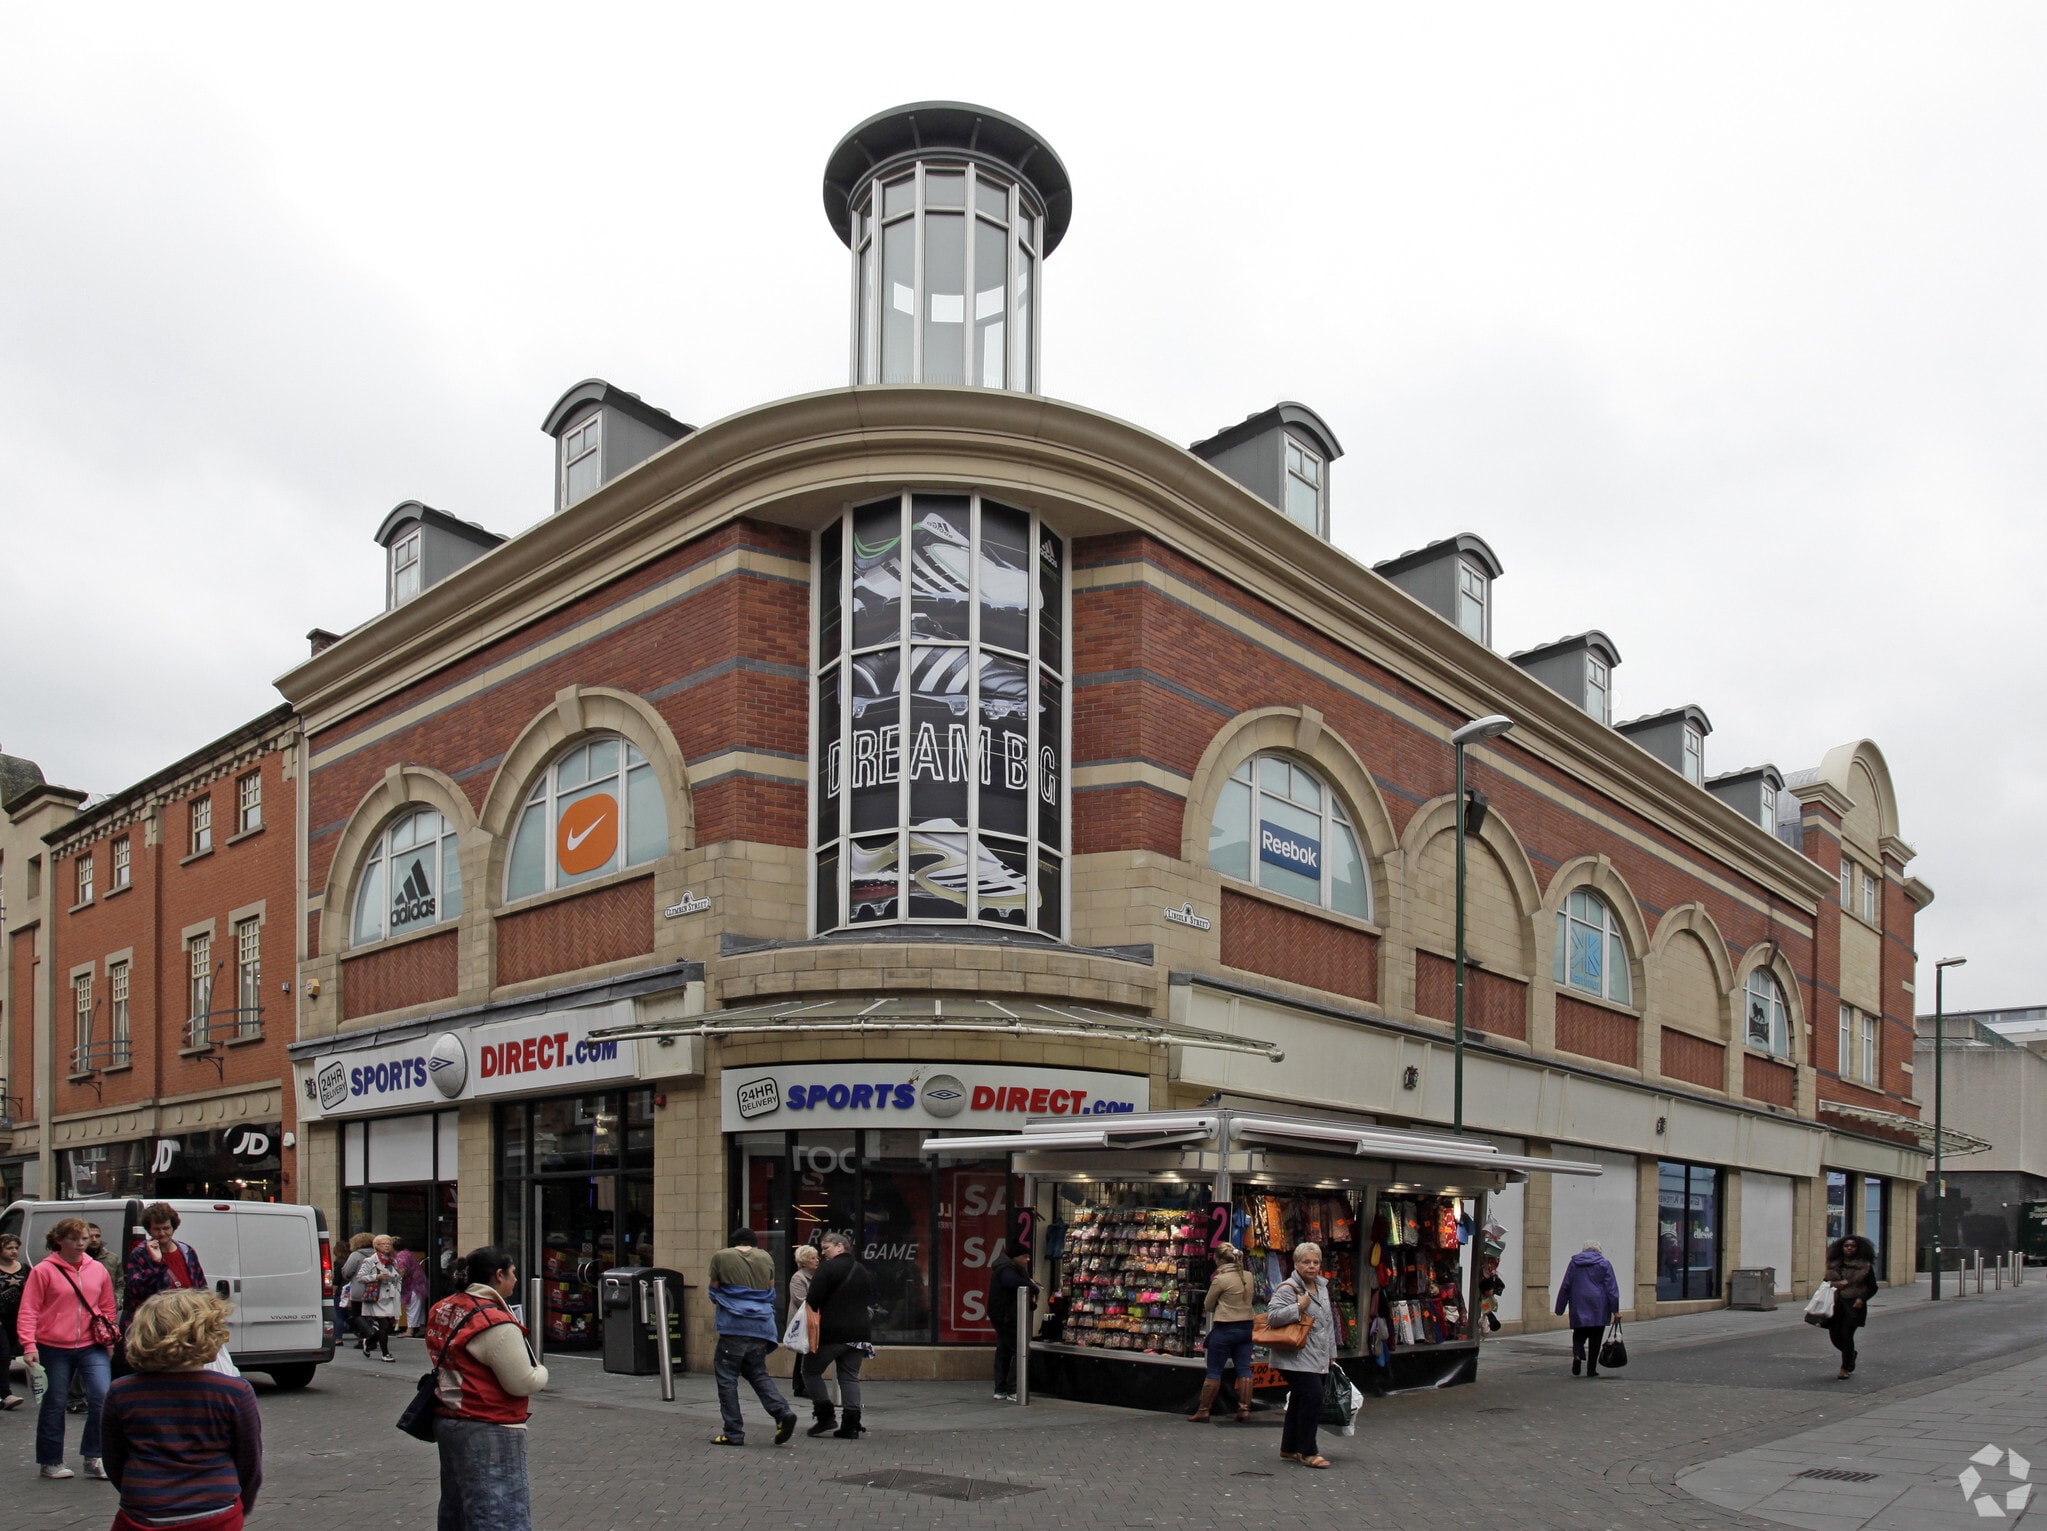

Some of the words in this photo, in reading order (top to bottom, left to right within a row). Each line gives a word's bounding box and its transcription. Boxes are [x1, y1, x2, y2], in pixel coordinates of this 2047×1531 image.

[828, 722, 991, 799] DREAM
[1003, 730, 1056, 806] BG
[1262, 829, 1318, 868] Reebok
[391, 897, 435, 927] adidas
[1190, 915, 1209, 929] STREET
[321, 1068, 343, 1092] 24HR
[350, 1056, 427, 1097] SPORTS
[322, 1081, 347, 1102] DELIVERY
[741, 1083, 774, 1103] 24HR
[742, 1095, 777, 1112] DELIVERY
[785, 1083, 916, 1110] SPORTS
[233, 1131, 270, 1155] JD
[151, 1139, 173, 1174] JD
[1209, 1206, 1228, 1249] 2
[863, 1243, 919, 1260] GAME
